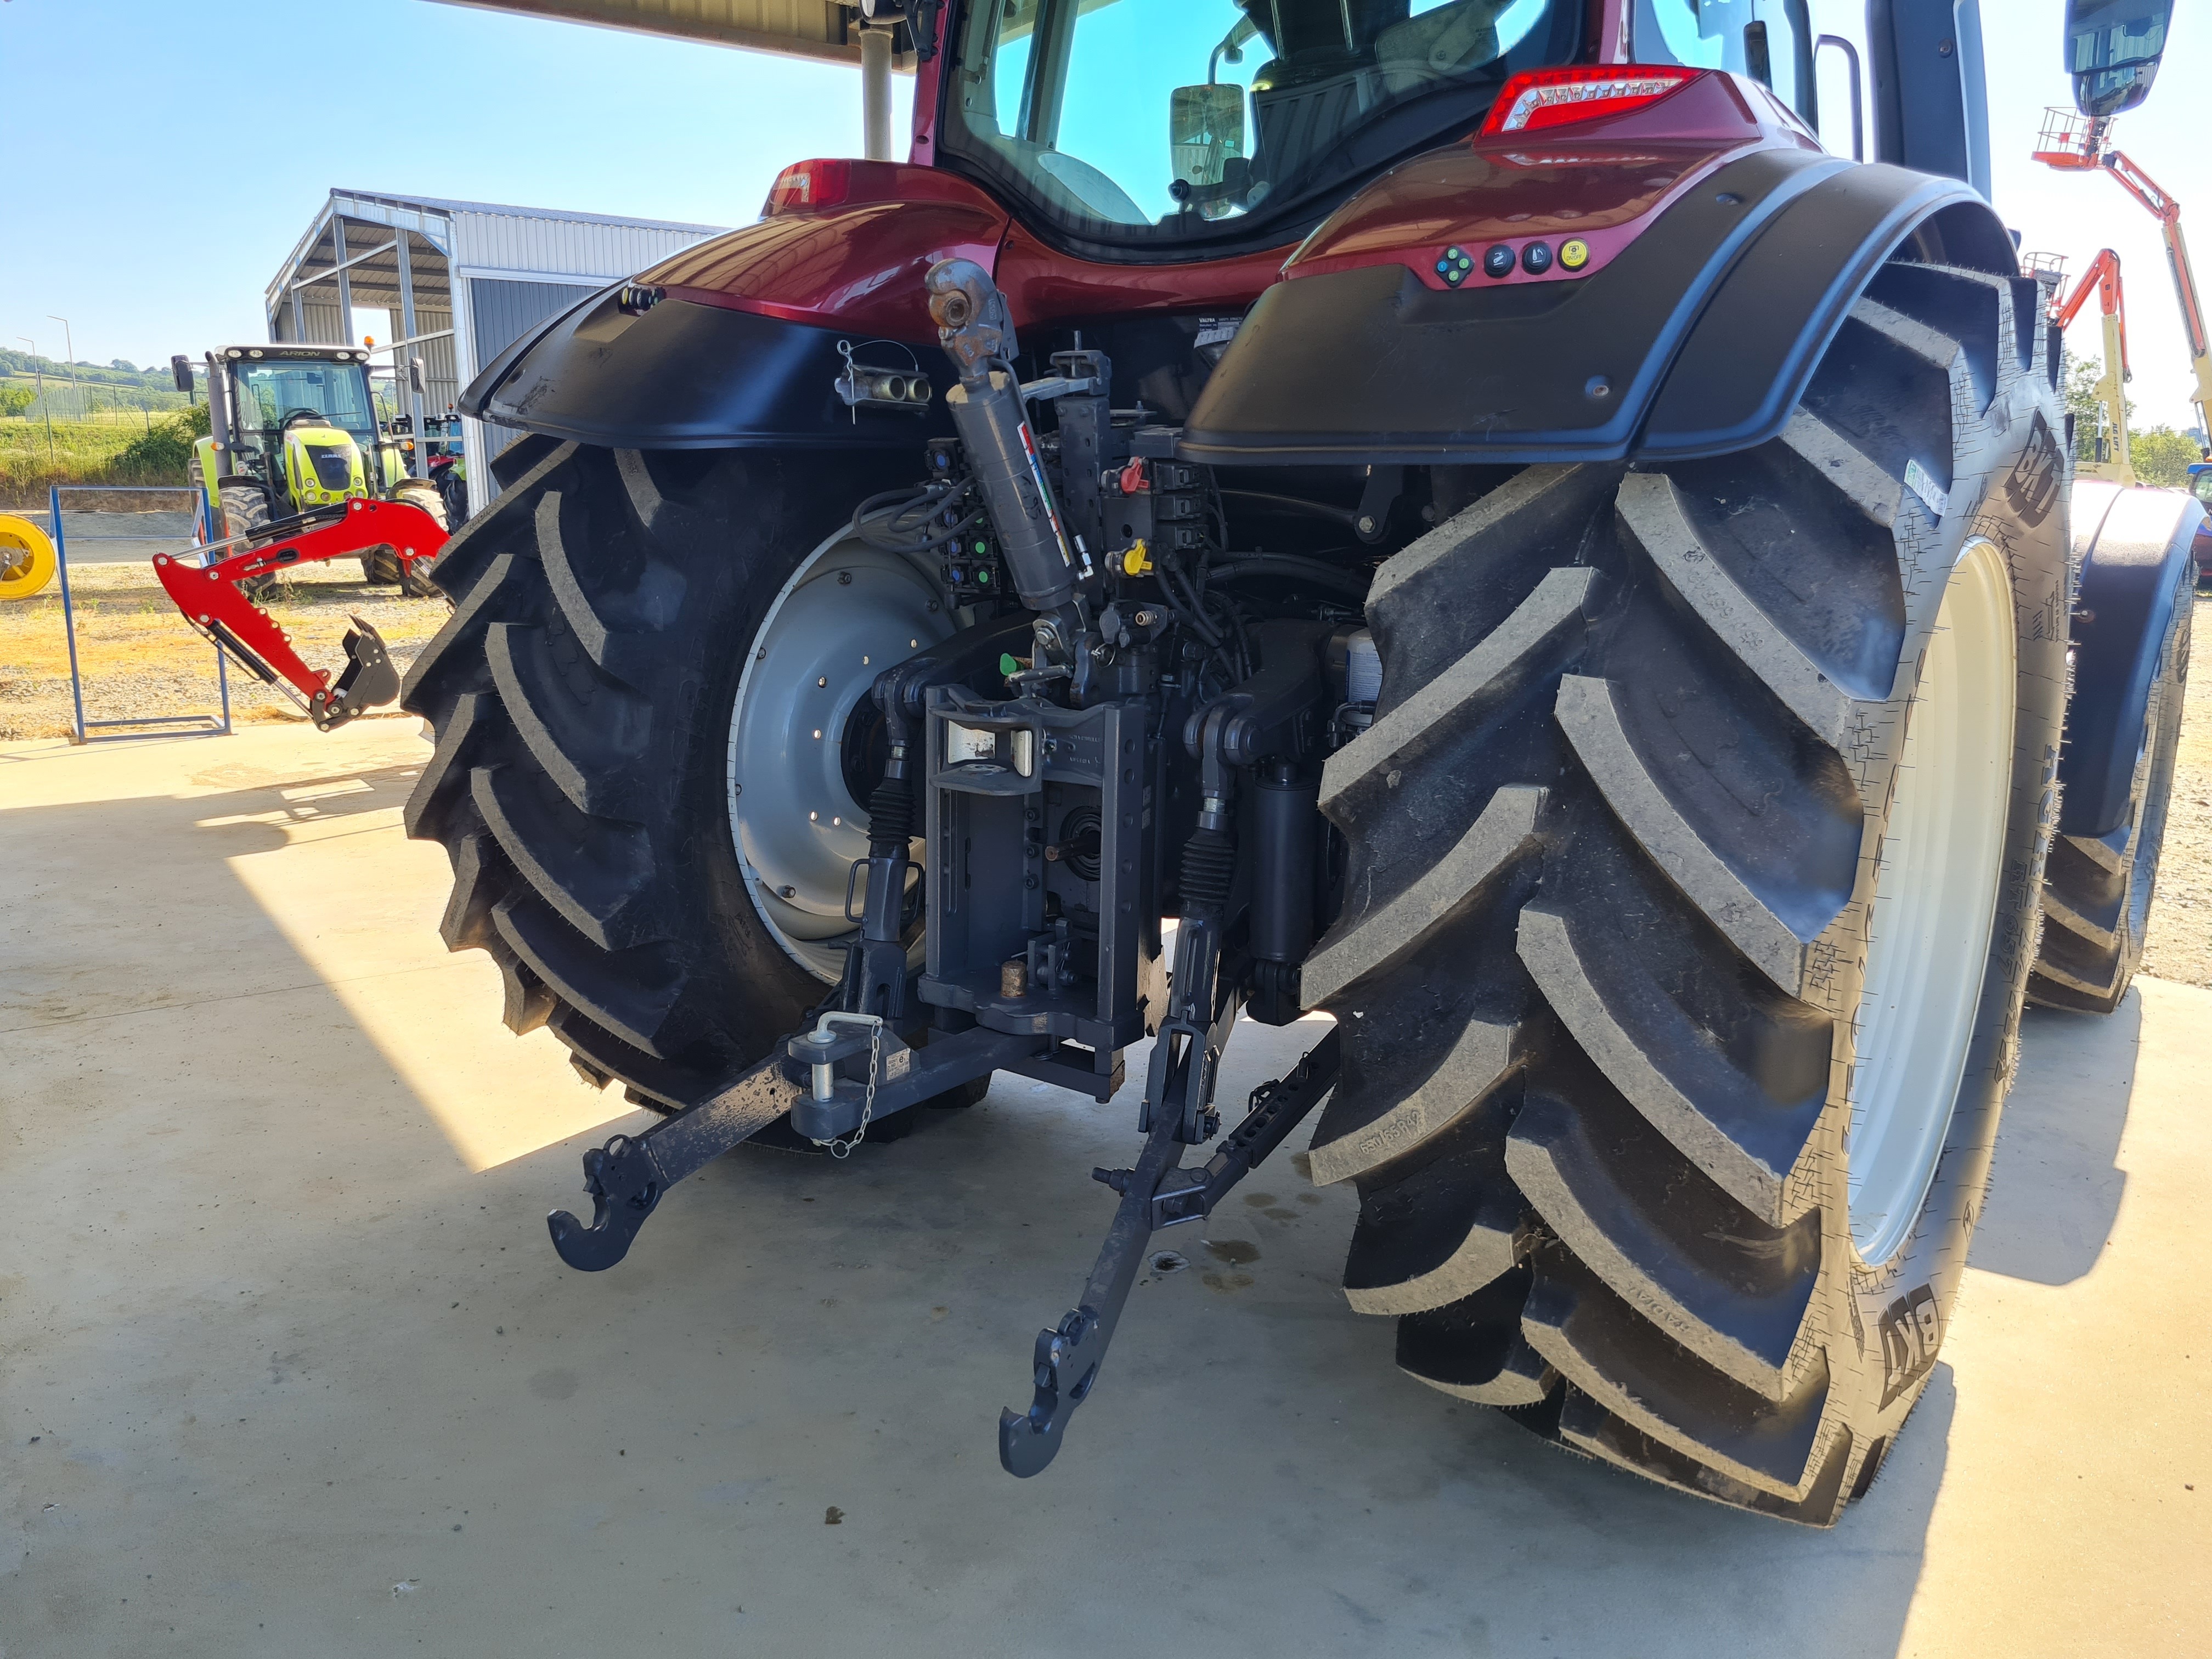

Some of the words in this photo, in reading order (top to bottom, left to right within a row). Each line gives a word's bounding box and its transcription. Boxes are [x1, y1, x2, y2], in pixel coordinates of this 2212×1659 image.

[2009, 418, 2064, 520] BKT
[1994, 743, 2058, 1085] AGRIMAX
[2007, 859, 2029, 911] RT
[1996, 913, 2022, 981] 657
[1882, 1290, 1940, 1402] BKT
